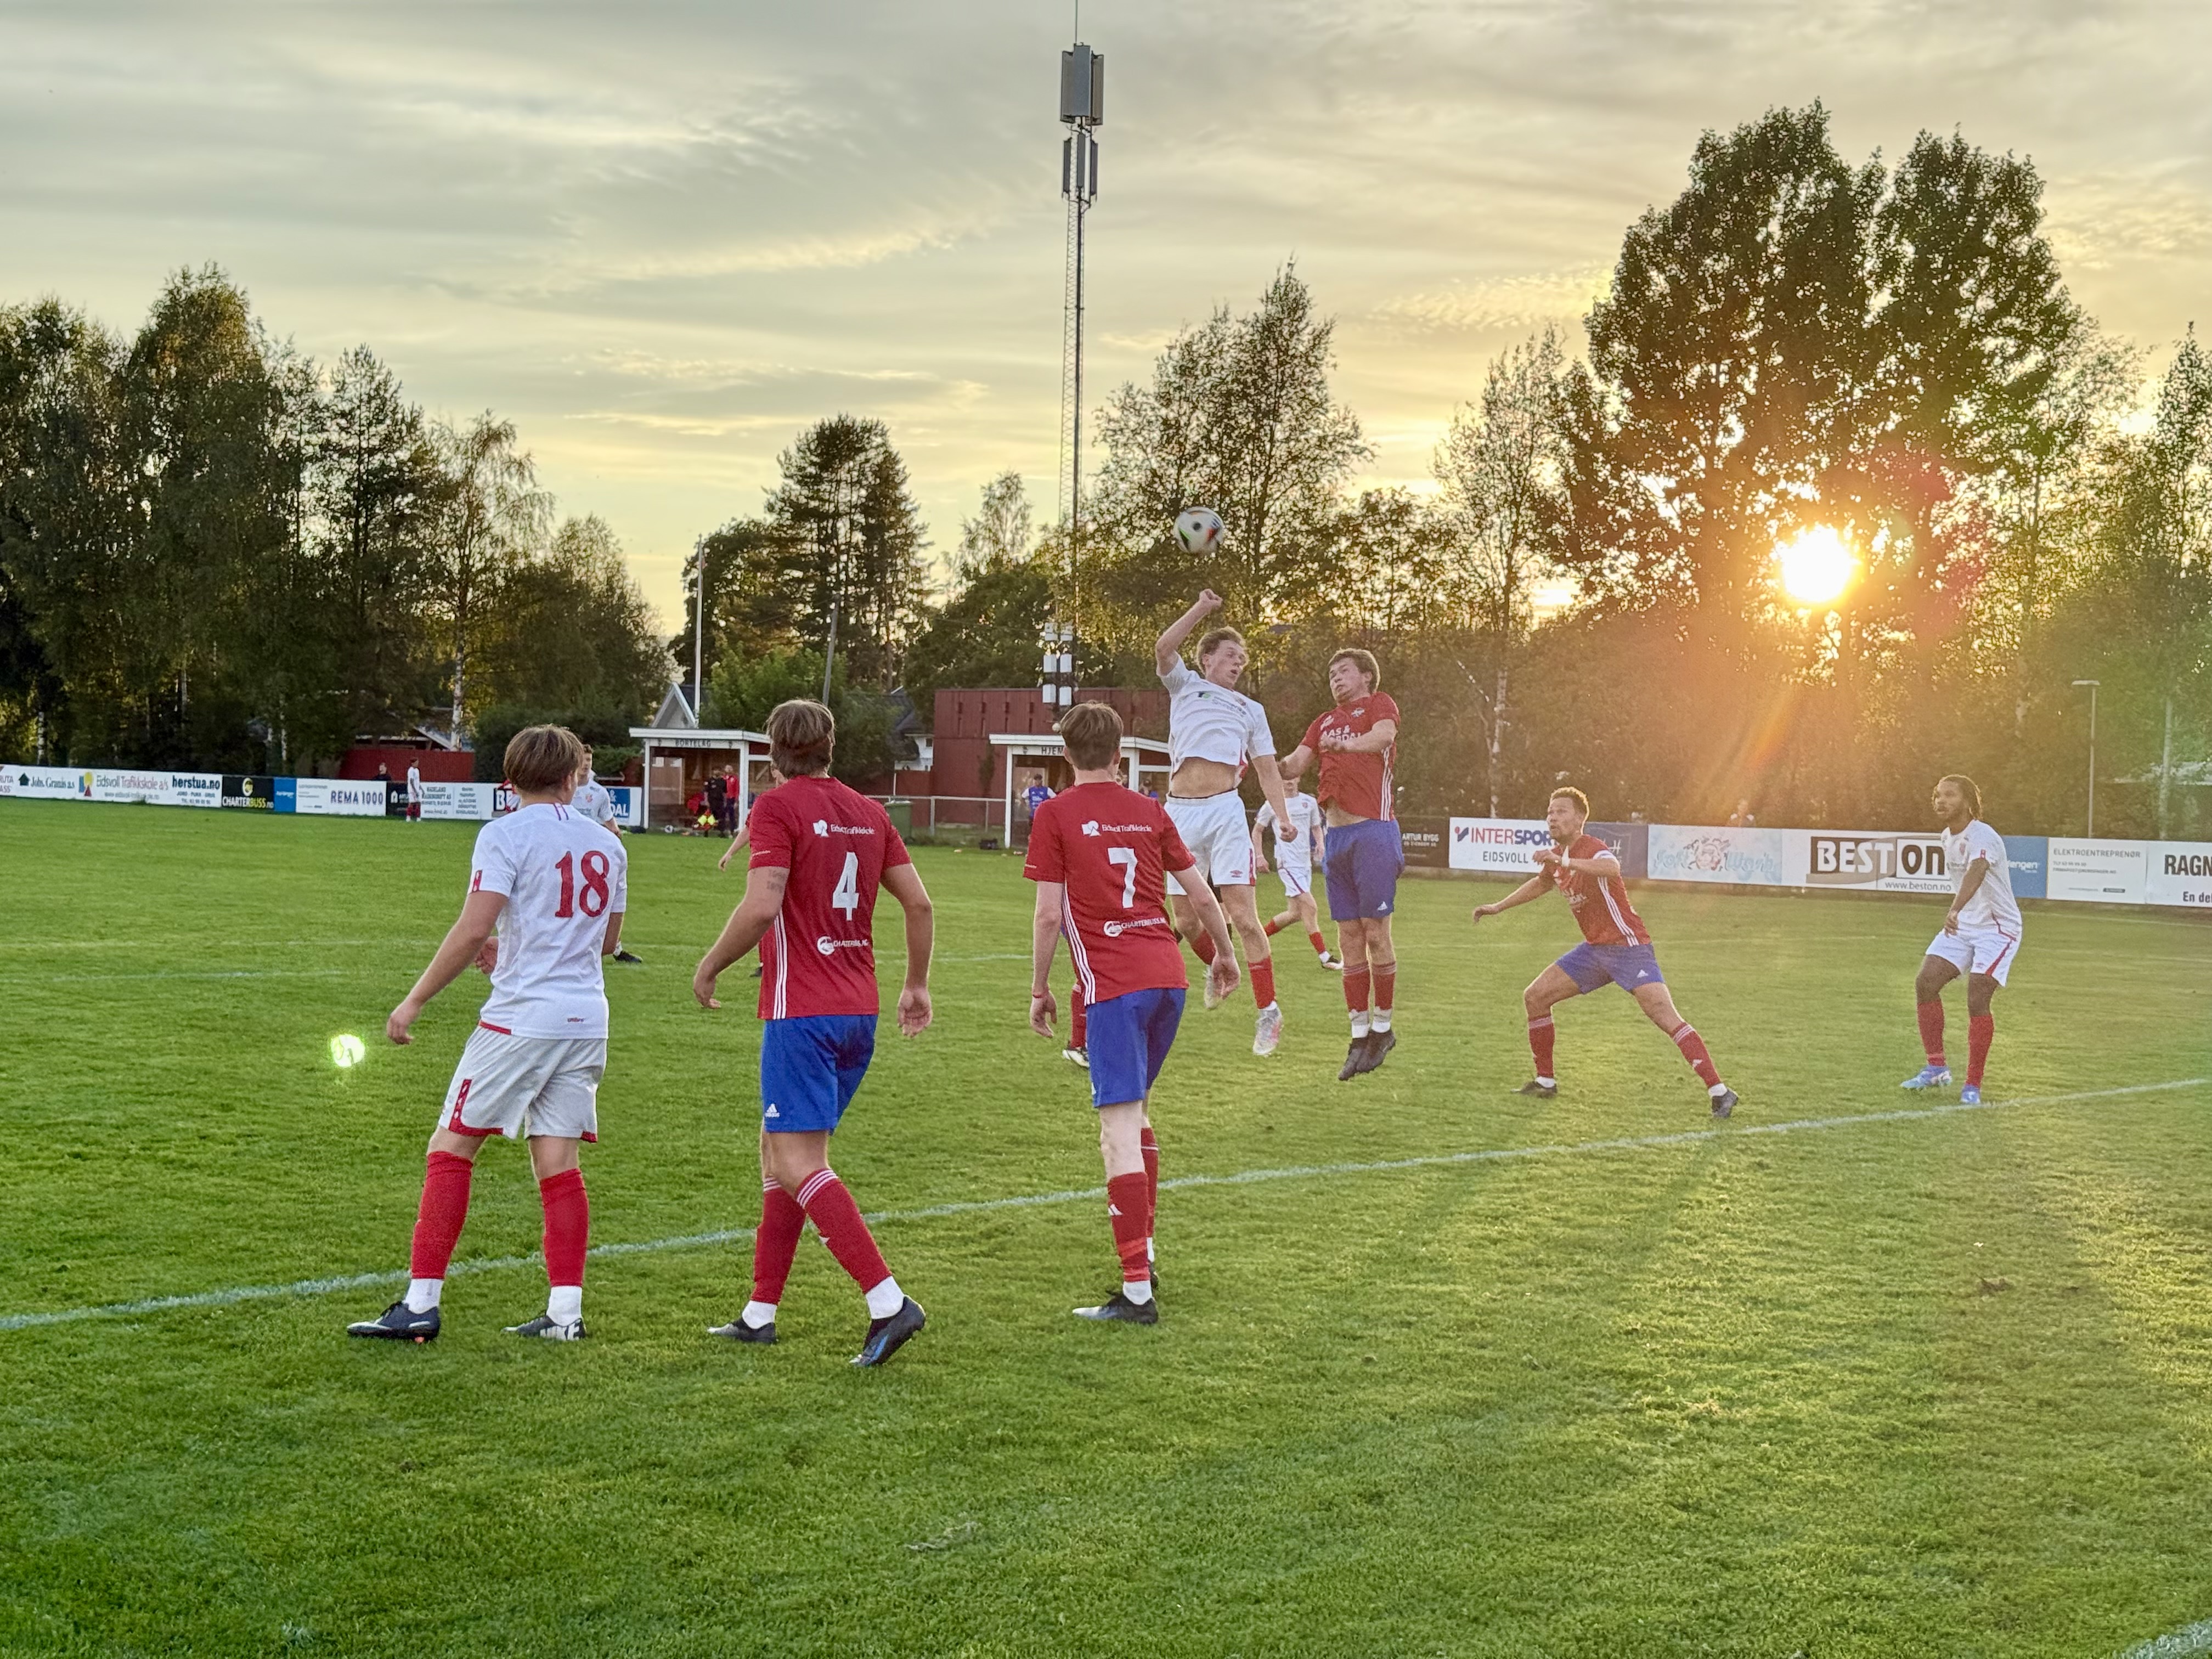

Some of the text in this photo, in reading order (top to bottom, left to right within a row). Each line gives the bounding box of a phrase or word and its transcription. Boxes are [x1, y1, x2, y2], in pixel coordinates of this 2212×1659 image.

[97, 775, 120, 788] Eidsvoll
[121, 776, 158, 790] Trafikkskole
[172, 775, 220, 790] herstua.no
[331, 791, 358, 804] REMA
[362, 791, 384, 805] 1000
[1471, 827, 1557, 846] INTERSPOR
[1483, 851, 1528, 864] EIDSVOLL
[2053, 848, 2141, 857] ELEKTROENTREPRENØR
[2164, 854, 2212, 877] RAGN
[555, 850, 610, 918] 18
[1107, 847, 1138, 909] 7
[832, 851, 860, 922] 4
[1885, 881, 1951, 892] www.beston.no
[2183, 891, 2195, 902] En
